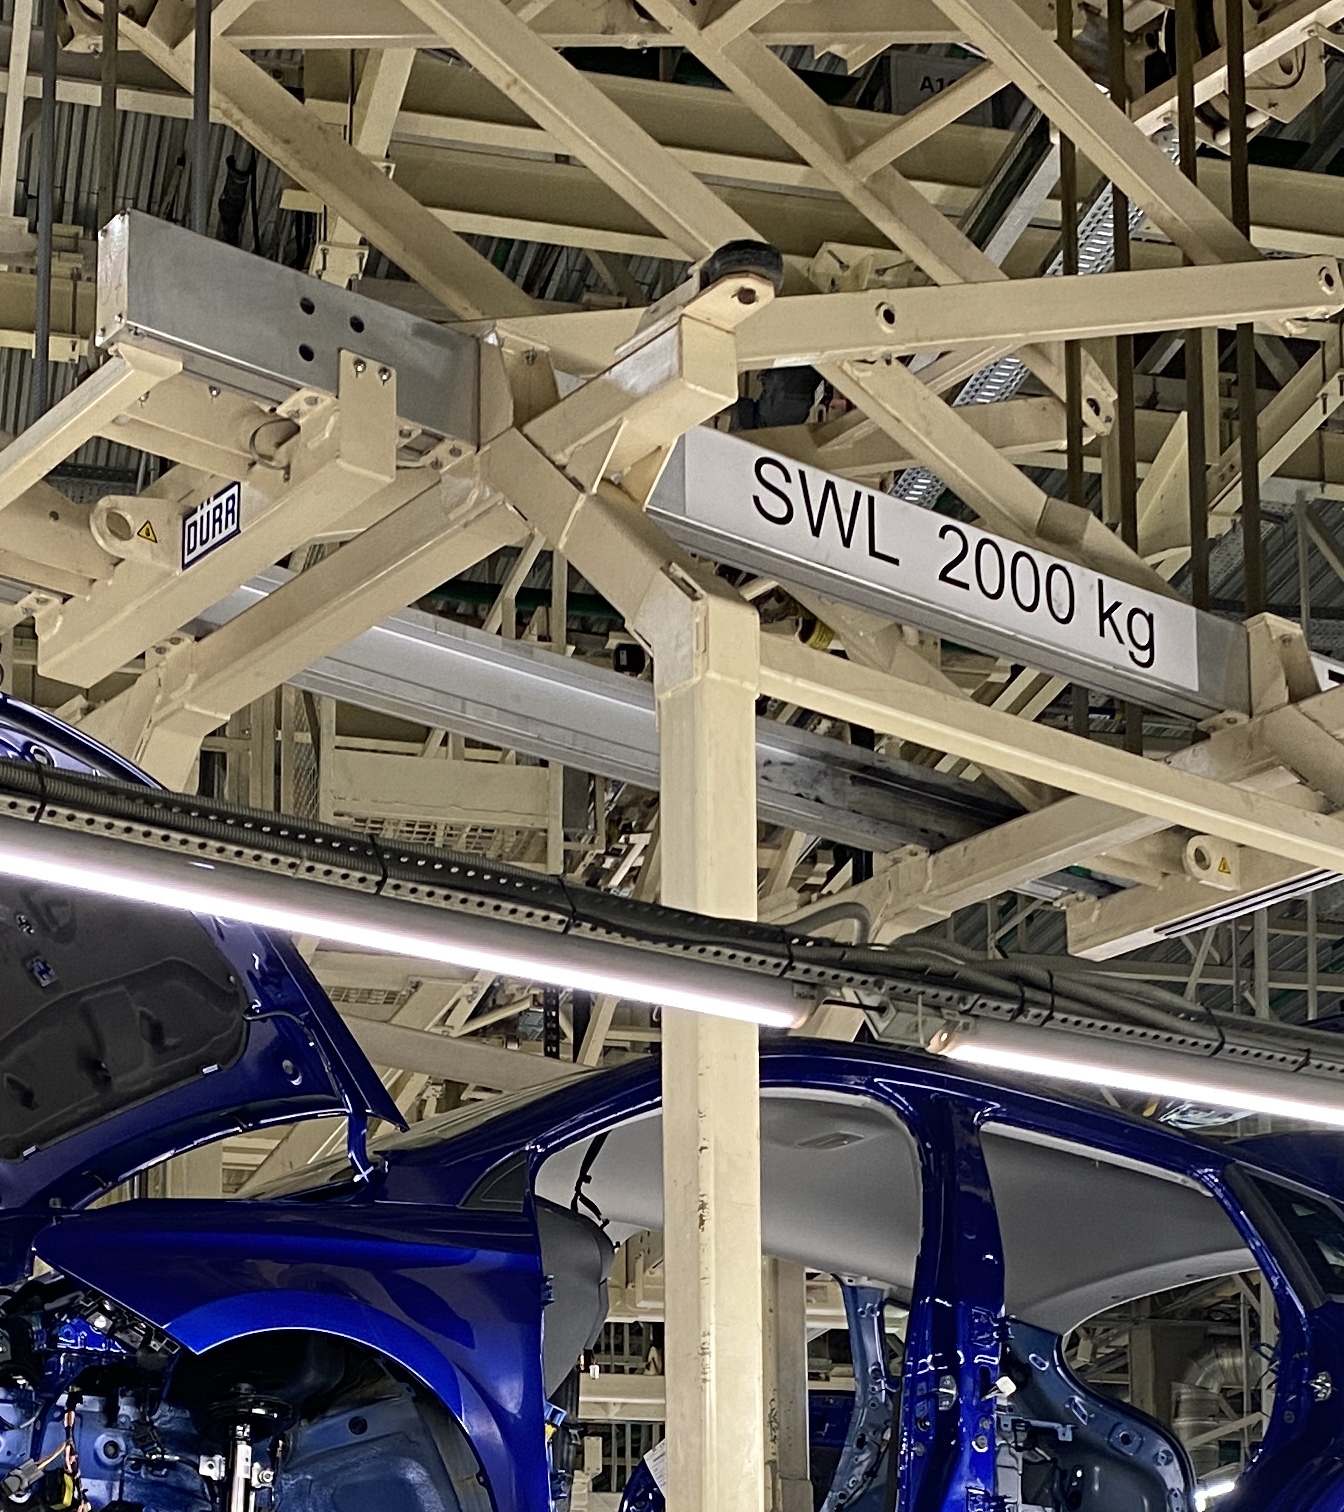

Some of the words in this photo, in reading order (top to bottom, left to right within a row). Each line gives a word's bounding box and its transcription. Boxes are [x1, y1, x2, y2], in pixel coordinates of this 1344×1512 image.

[919, 76, 957, 93] A1
[186, 493, 236, 557] DÜRR
[752, 457, 899, 566] SWL
[938, 525, 1075, 625] 2000
[1097, 579, 1155, 668] kg
